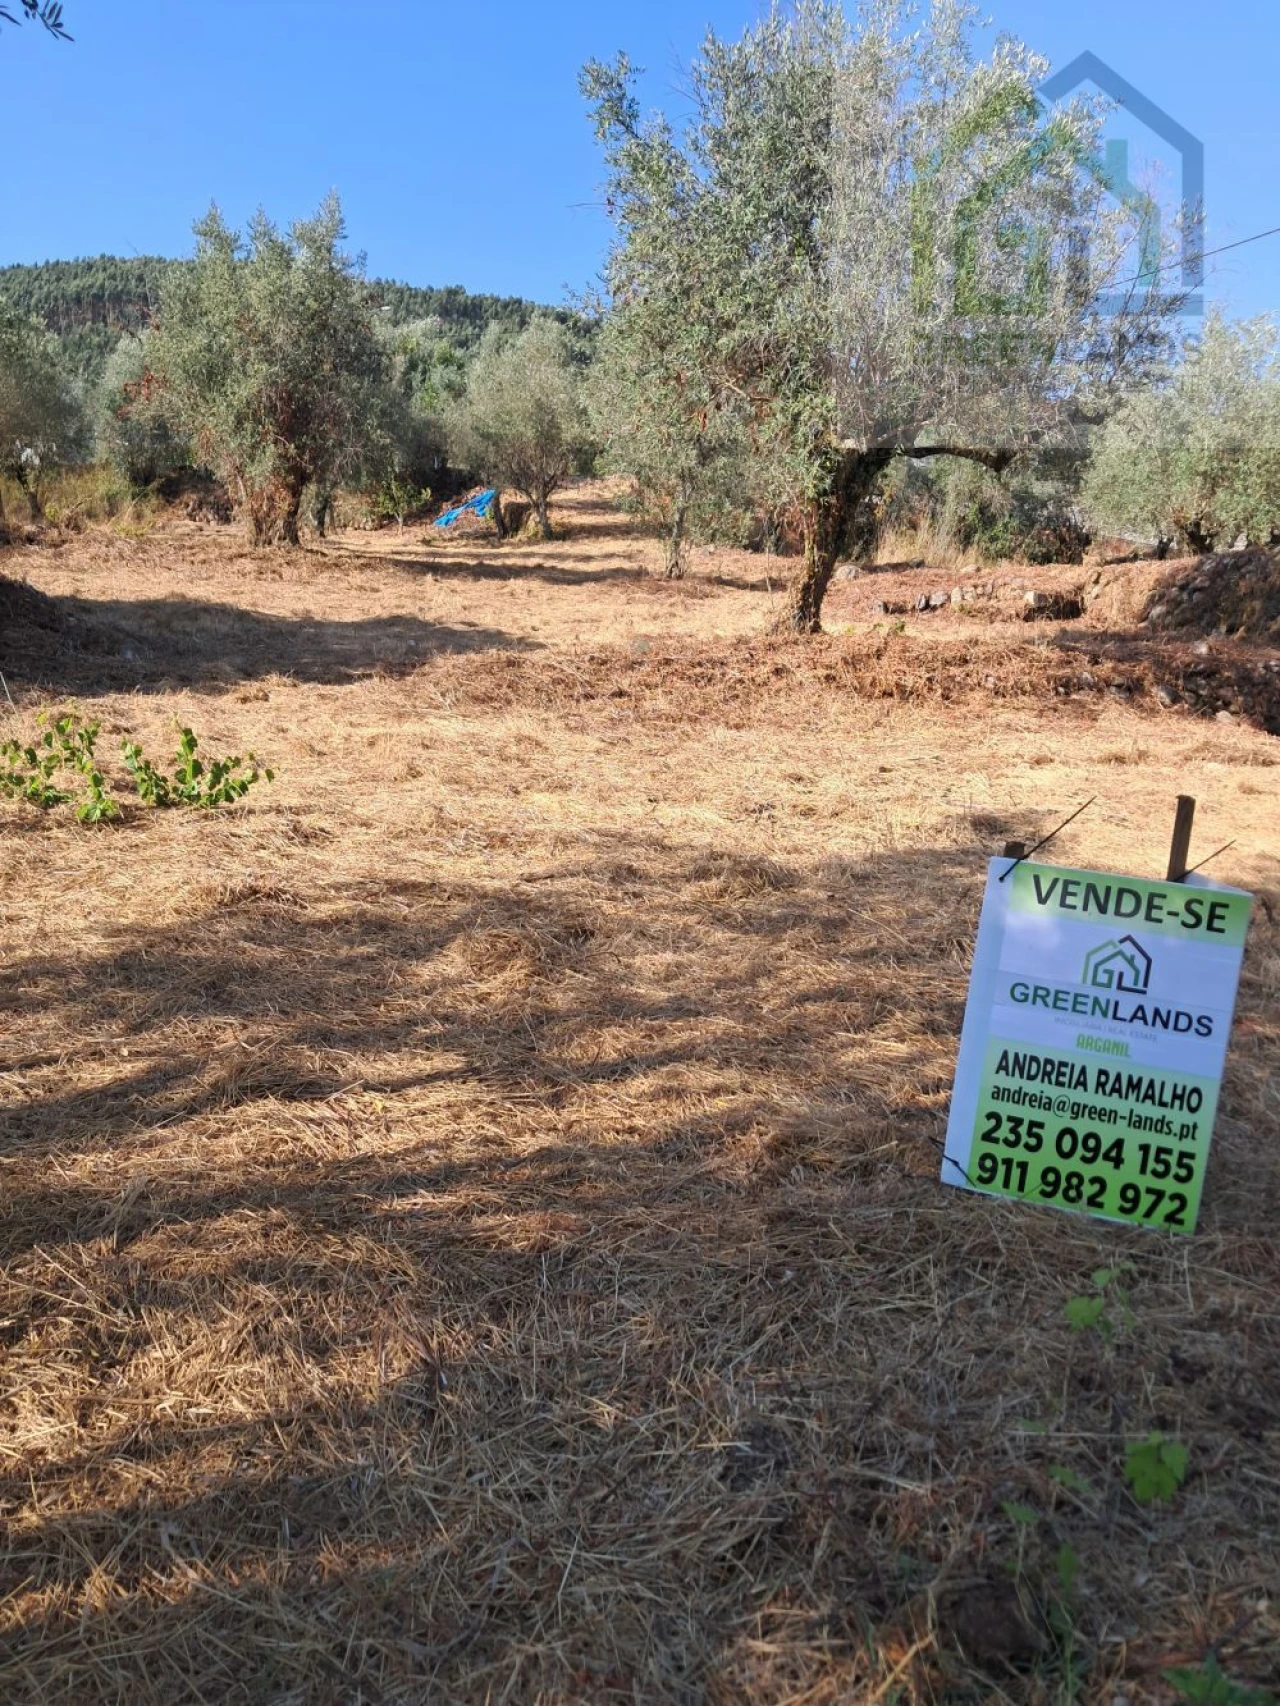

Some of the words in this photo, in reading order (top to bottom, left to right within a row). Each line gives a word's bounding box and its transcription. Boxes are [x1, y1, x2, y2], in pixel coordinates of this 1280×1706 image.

[1033, 874, 1230, 933] VENDE-SE
[1010, 982, 1214, 1037] GREENLANDS
[1076, 1034, 1131, 1058] ARGANIL
[995, 1049, 1088, 1092] ANDREIA
[1094, 1068, 1203, 1114] RAMALHO
[991, 1083, 1199, 1141] andreia@green-lands.pt
[981, 1111, 1045, 1153] 235
[1055, 1127, 1125, 1170] 094
[1138, 1143, 1197, 1184] 155
[976, 1153, 1029, 1193] 911
[1039, 1166, 1107, 1209] 982
[1117, 1183, 1188, 1226] 972
